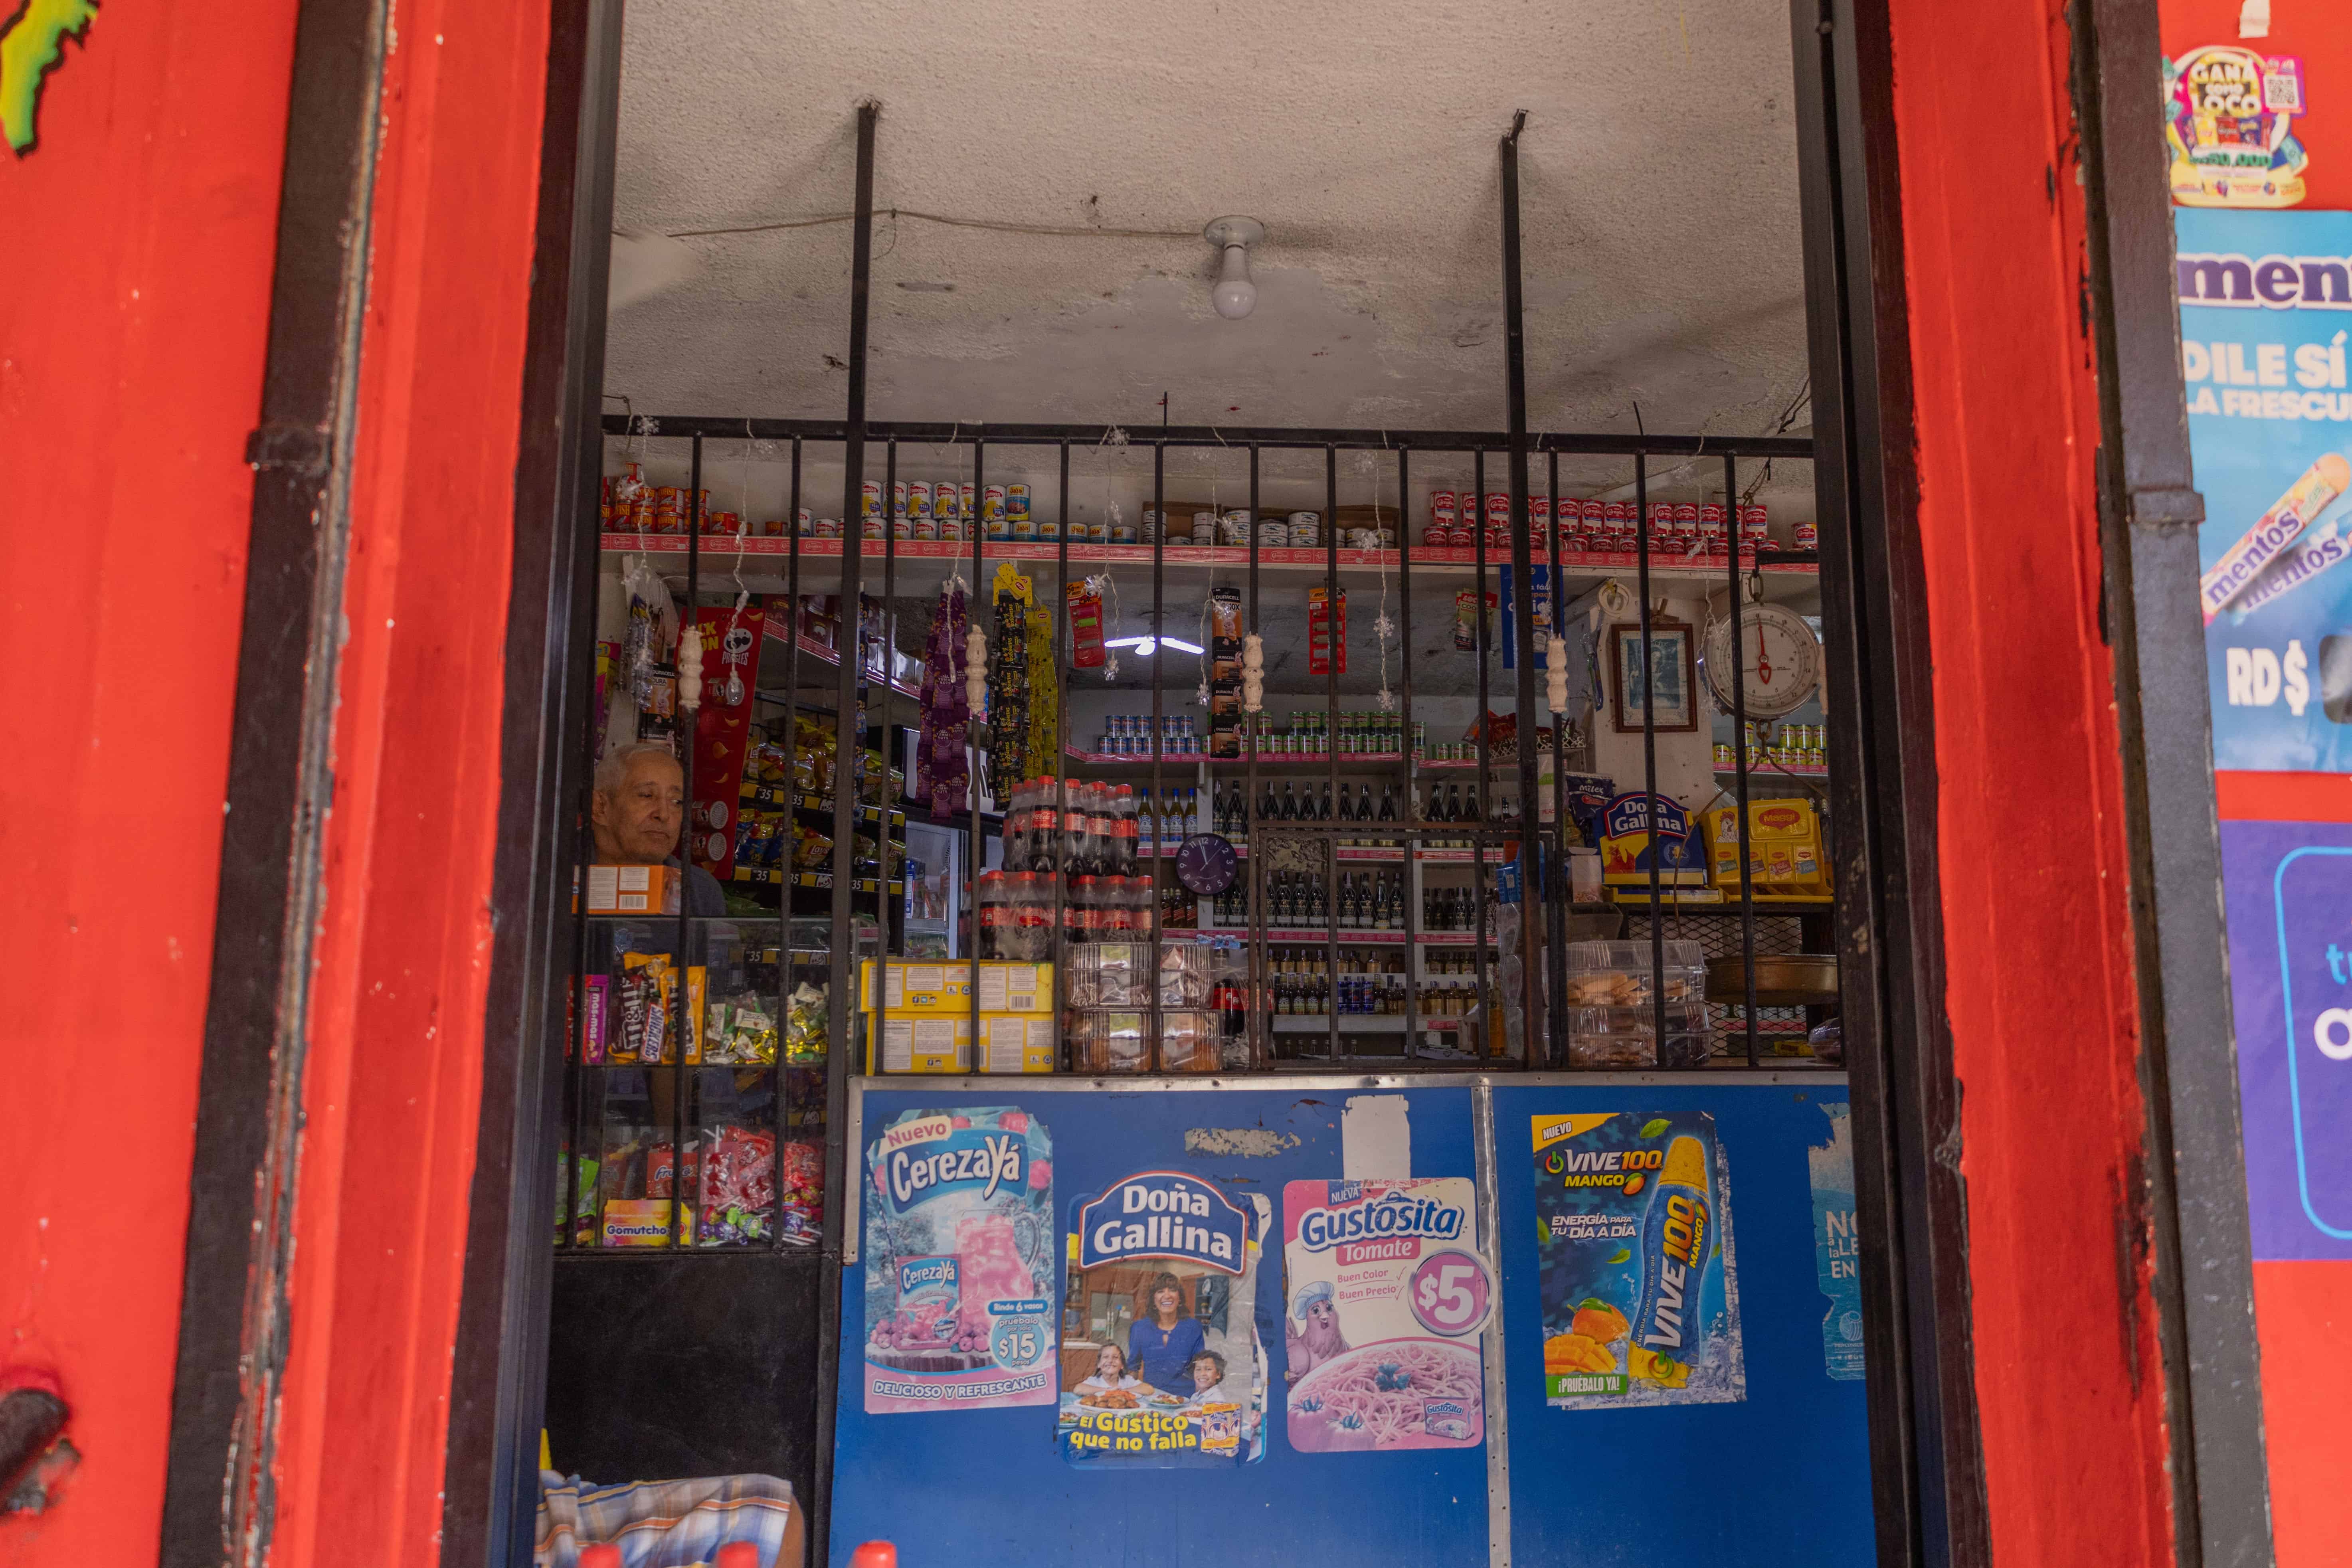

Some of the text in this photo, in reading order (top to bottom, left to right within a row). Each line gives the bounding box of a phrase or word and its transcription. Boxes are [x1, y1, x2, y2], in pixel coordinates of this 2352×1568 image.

[2193, 58, 2257, 83] GANA
[2206, 83, 2244, 95] COMO
[2193, 92, 2261, 115] LOCO
[2182, 329, 2348, 388] DILE SÍ
[2222, 389, 2352, 421] FRESCU
[2208, 511, 2299, 605] mentos
[2226, 639, 2310, 716] RD$
[761, 788, 772, 799] 35
[1579, 784, 1604, 794] Milex
[1625, 801, 1667, 814] Doa
[1615, 816, 1681, 831] Gallna
[1763, 813, 1795, 823] Maggi
[757, 870, 768, 881] 35
[645, 1006, 665, 1061] SNICKERS
[888, 1121, 946, 1147] Nuevo
[1543, 1121, 1572, 1141] NUEVO
[1564, 1150, 1662, 1172] VIVE100
[1565, 1173, 1624, 1187] MANGO
[1123, 1181, 1210, 1217] Doña
[1331, 1188, 1359, 1203] NUEVA
[1302, 1198, 1464, 1246] Gustosita
[1551, 1212, 1608, 1227] ENERGÍA
[606, 1225, 667, 1236] Gomutcho
[1094, 1216, 1232, 1260] Gallina
[1551, 1222, 1637, 1239] TU DÍA A DÍA
[1343, 1241, 1412, 1262] Tomate
[1689, 1217, 1704, 1269] MANGO
[1829, 1246, 1839, 1258] la
[1337, 1268, 1389, 1283] Buen Color
[1831, 1261, 1855, 1279] EN
[1339, 1285, 1397, 1300] Buen Precio
[1418, 1264, 1475, 1325] $5
[1647, 1287, 1653, 1297] TU
[993, 1303, 1015, 1311] Rinde
[1016, 1302, 1023, 1312] 6
[999, 1316, 1039, 1329] pruébalo
[999, 1332, 1037, 1360] $15
[874, 1373, 1046, 1398] DELICIOSO Y REFRESCANTE
[1559, 1375, 1620, 1394] ¡PRUÉBALO YA!
[1080, 1412, 1189, 1434] El Gustico
[1070, 1429, 1197, 1450] que no falla
